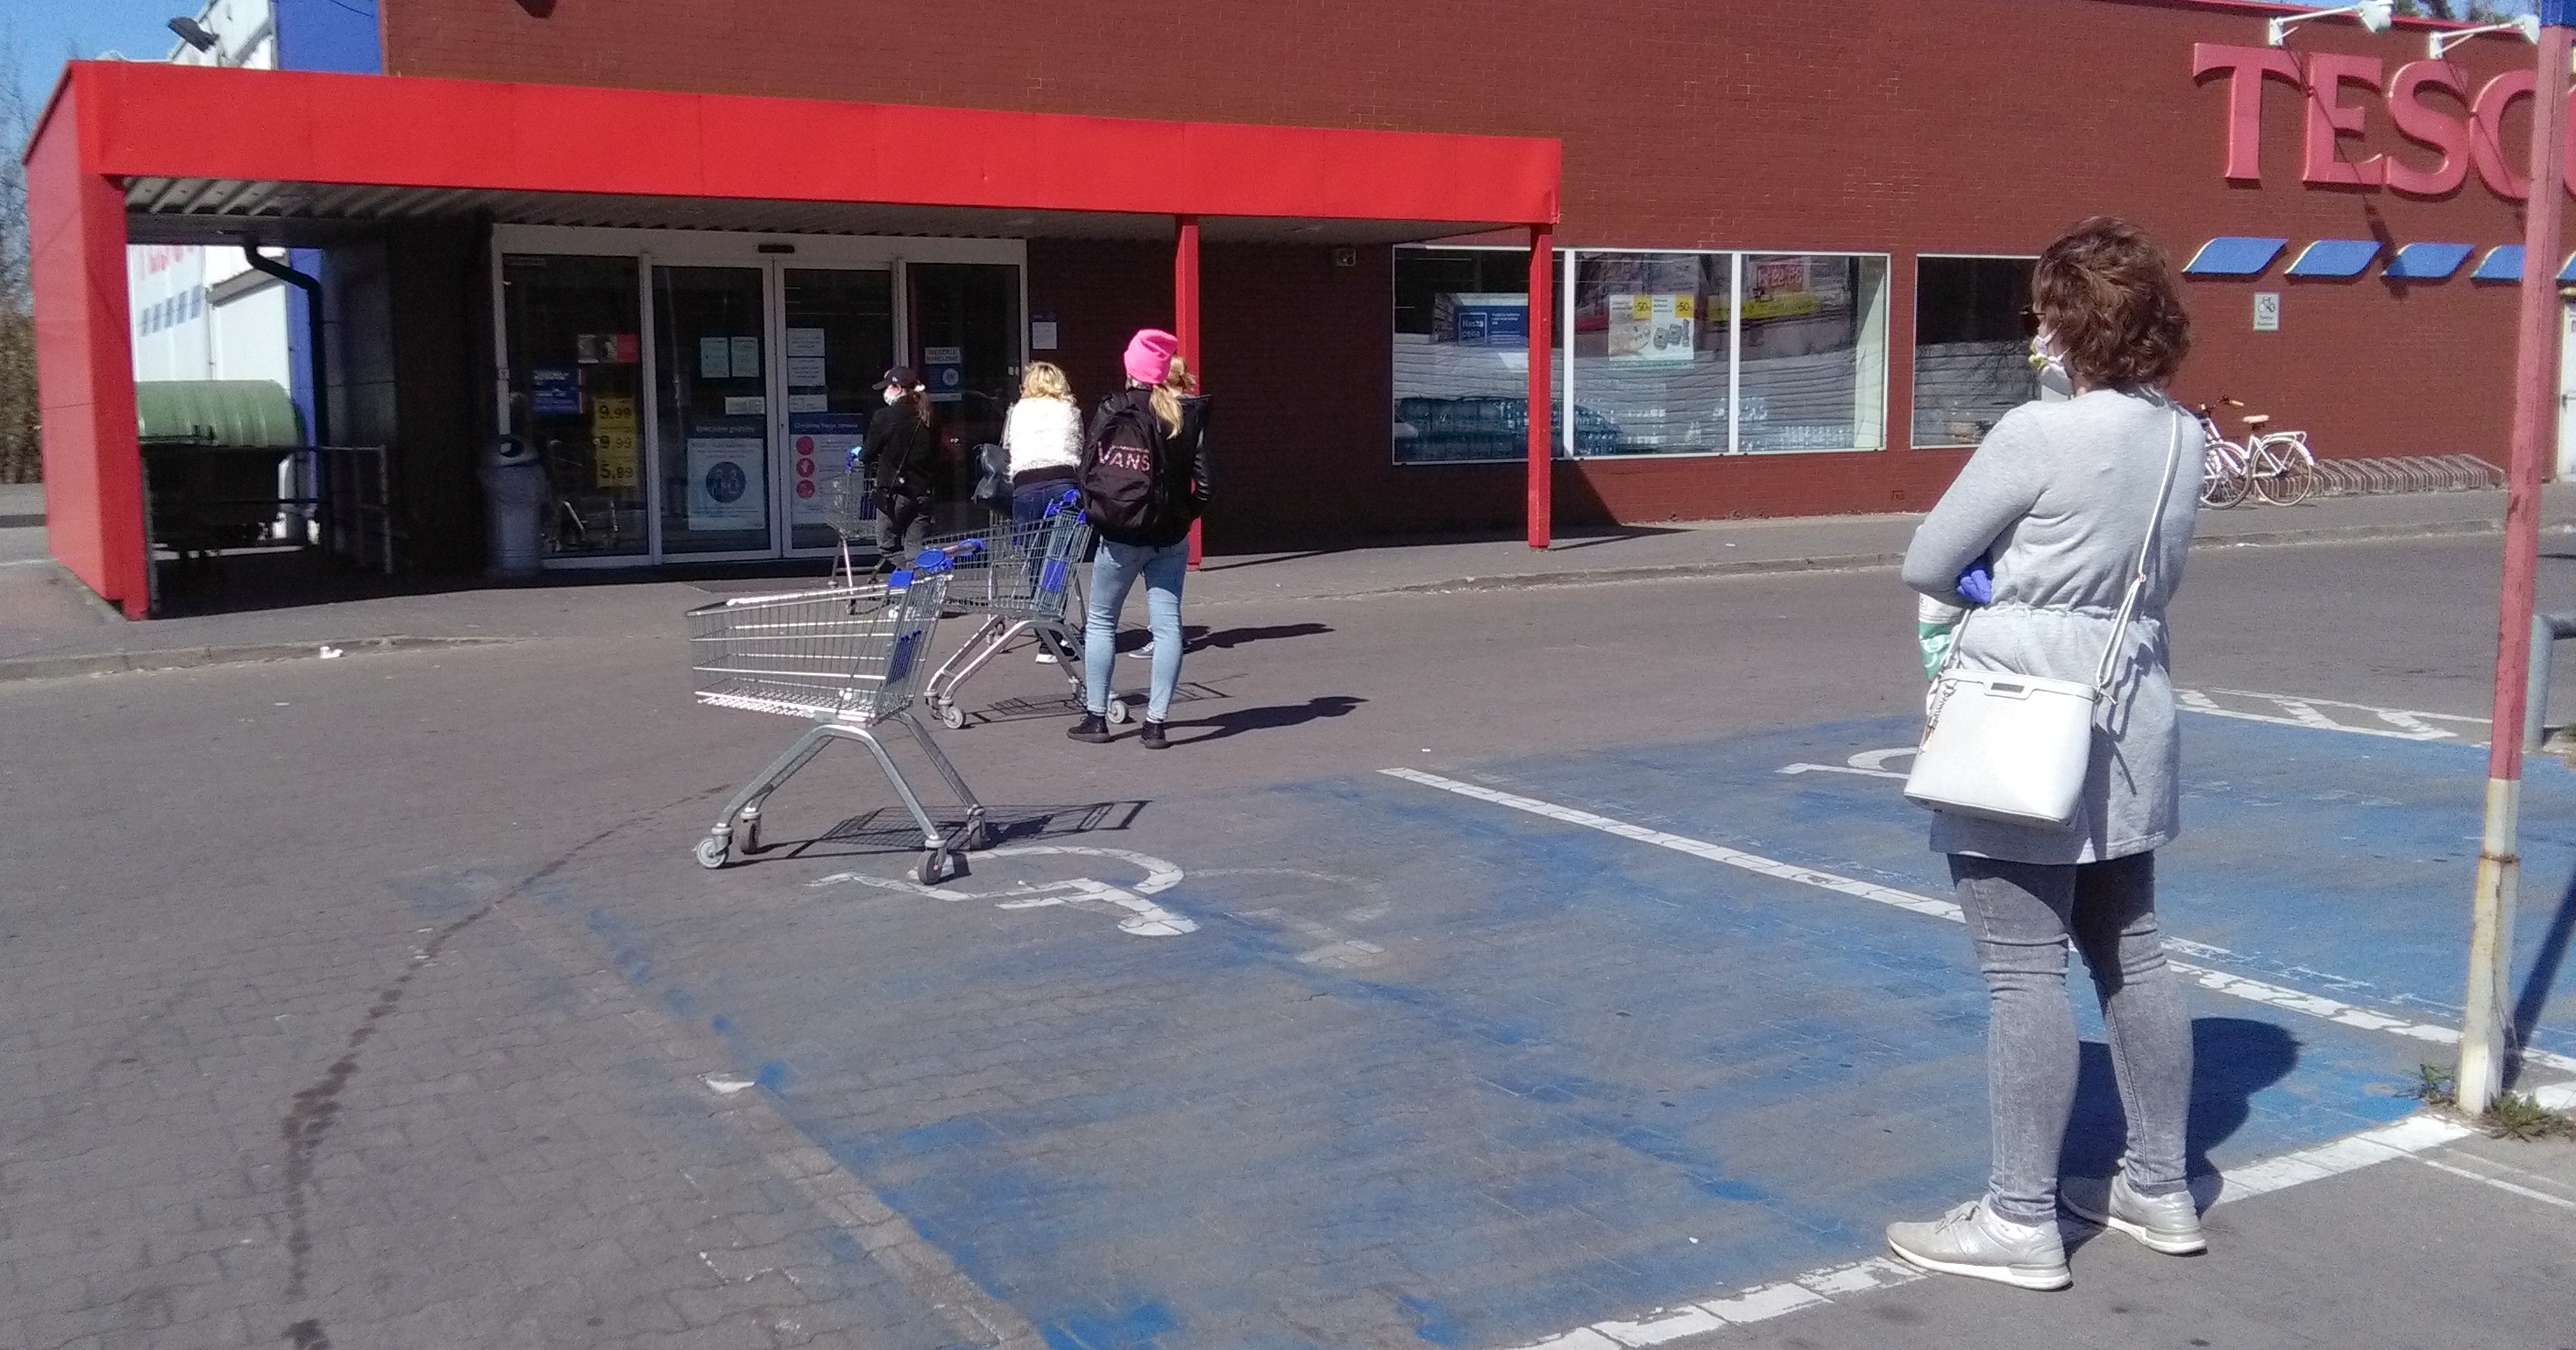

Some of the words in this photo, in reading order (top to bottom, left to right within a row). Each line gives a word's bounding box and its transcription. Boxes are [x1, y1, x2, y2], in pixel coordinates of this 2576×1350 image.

[2193, 42, 2576, 199] TESC
[1461, 319, 1484, 328] Nasza
[1097, 441, 1151, 472] VANS
